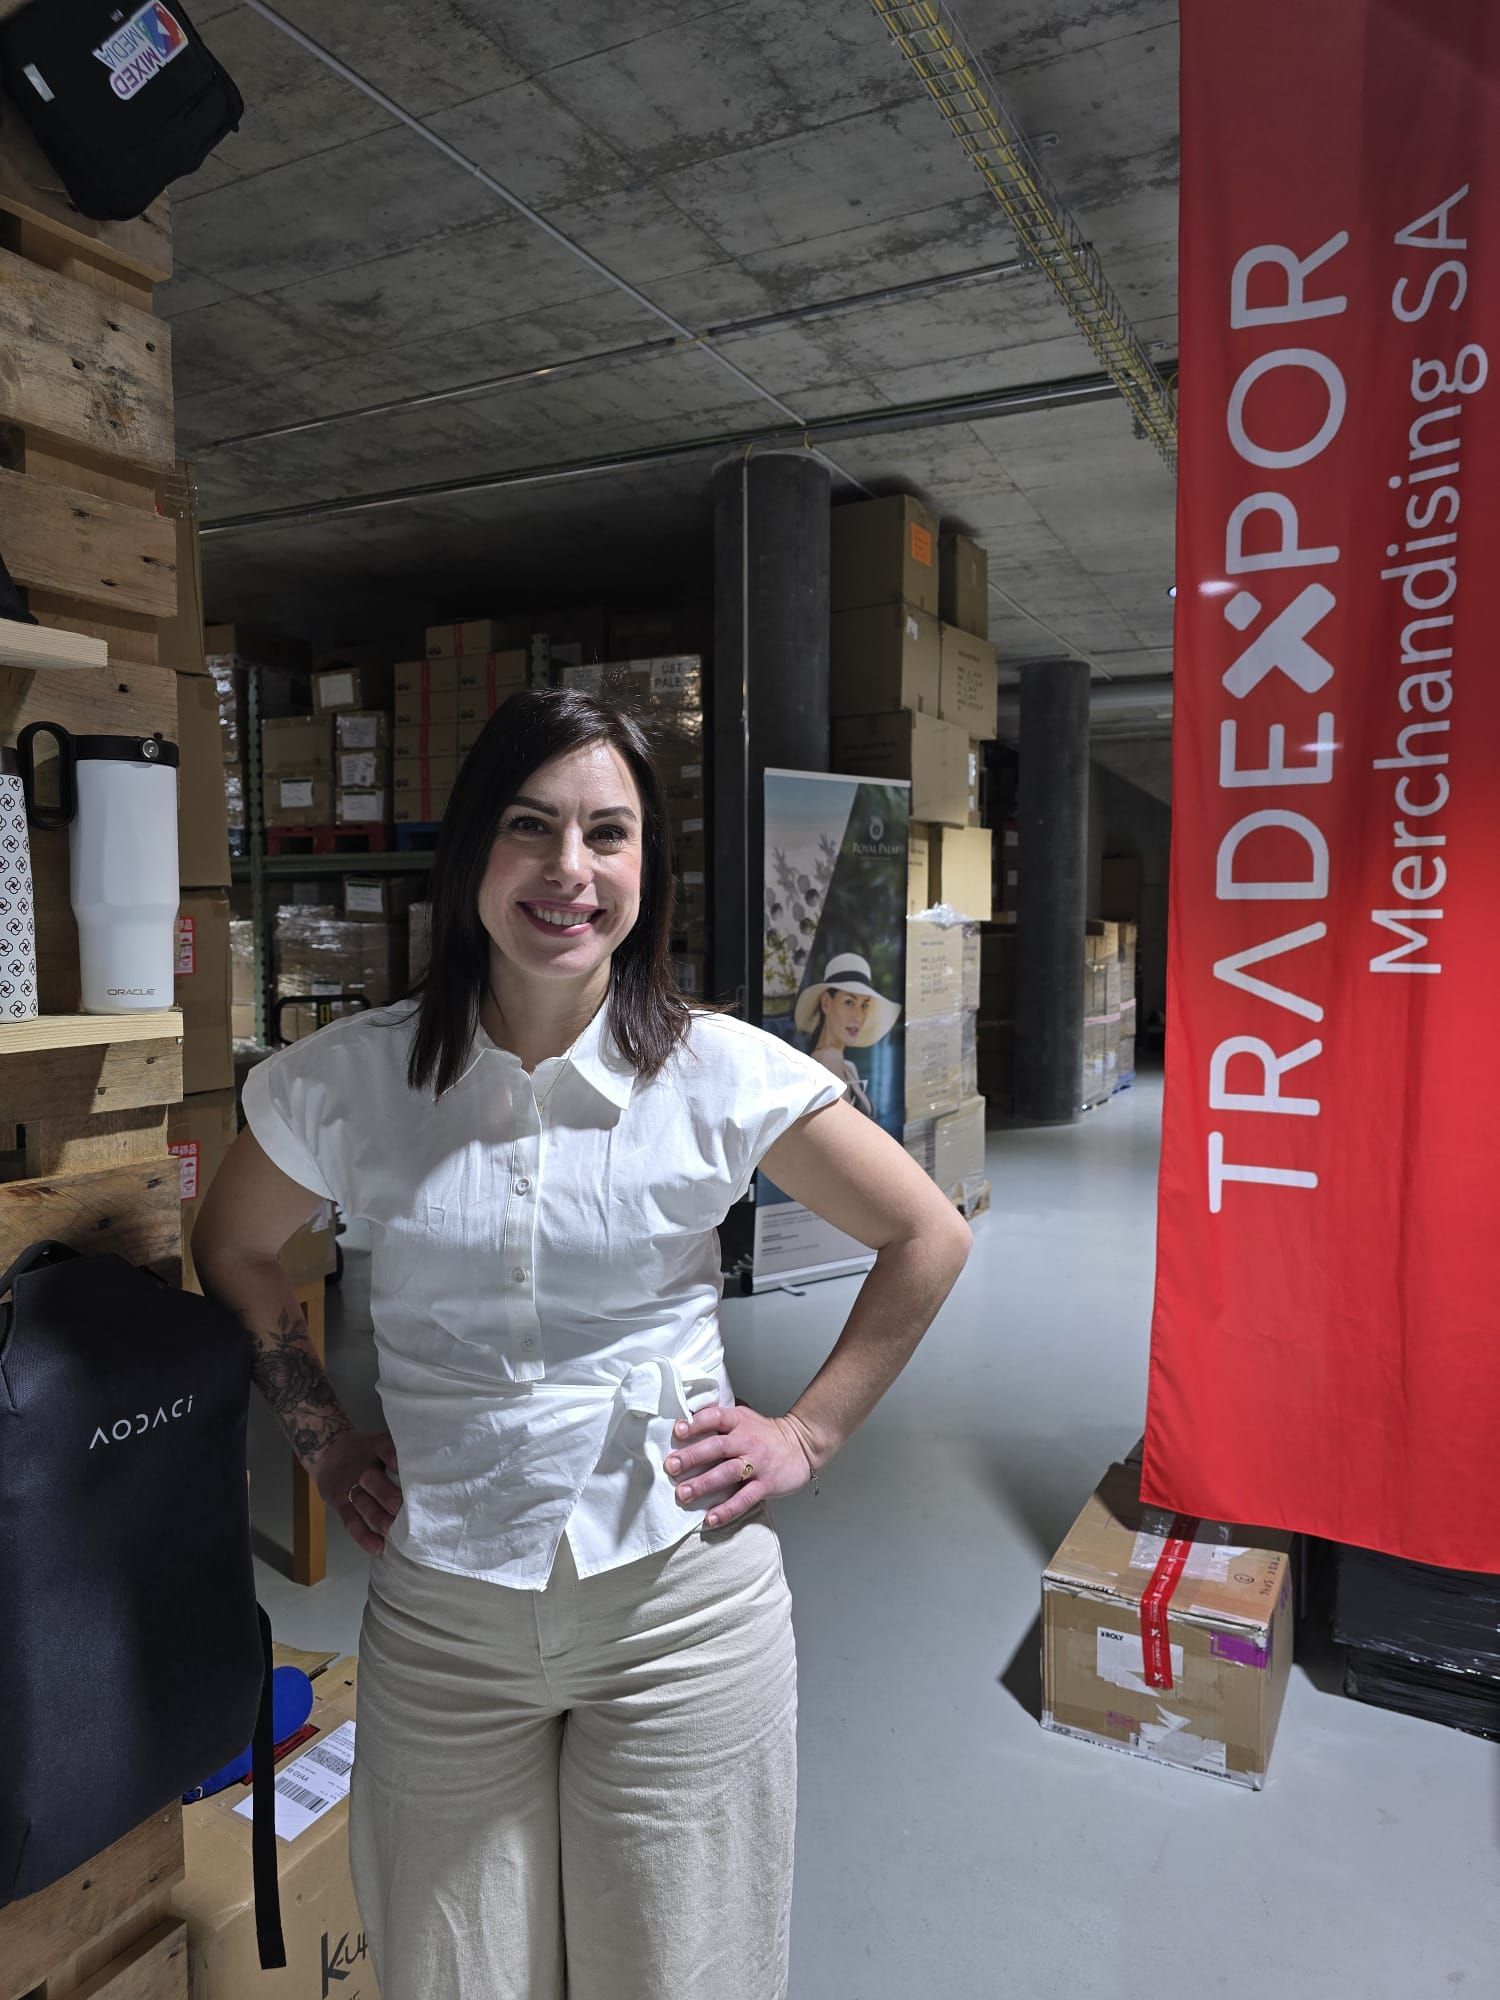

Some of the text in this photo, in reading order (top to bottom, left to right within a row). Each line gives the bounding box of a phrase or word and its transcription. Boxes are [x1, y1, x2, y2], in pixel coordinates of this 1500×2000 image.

[99, 25, 145, 69] MEDIA
[114, 46, 162, 96] MIXED
[1369, 183, 1488, 975] Merchandising SA
[107, 988, 156, 996] ORACLE
